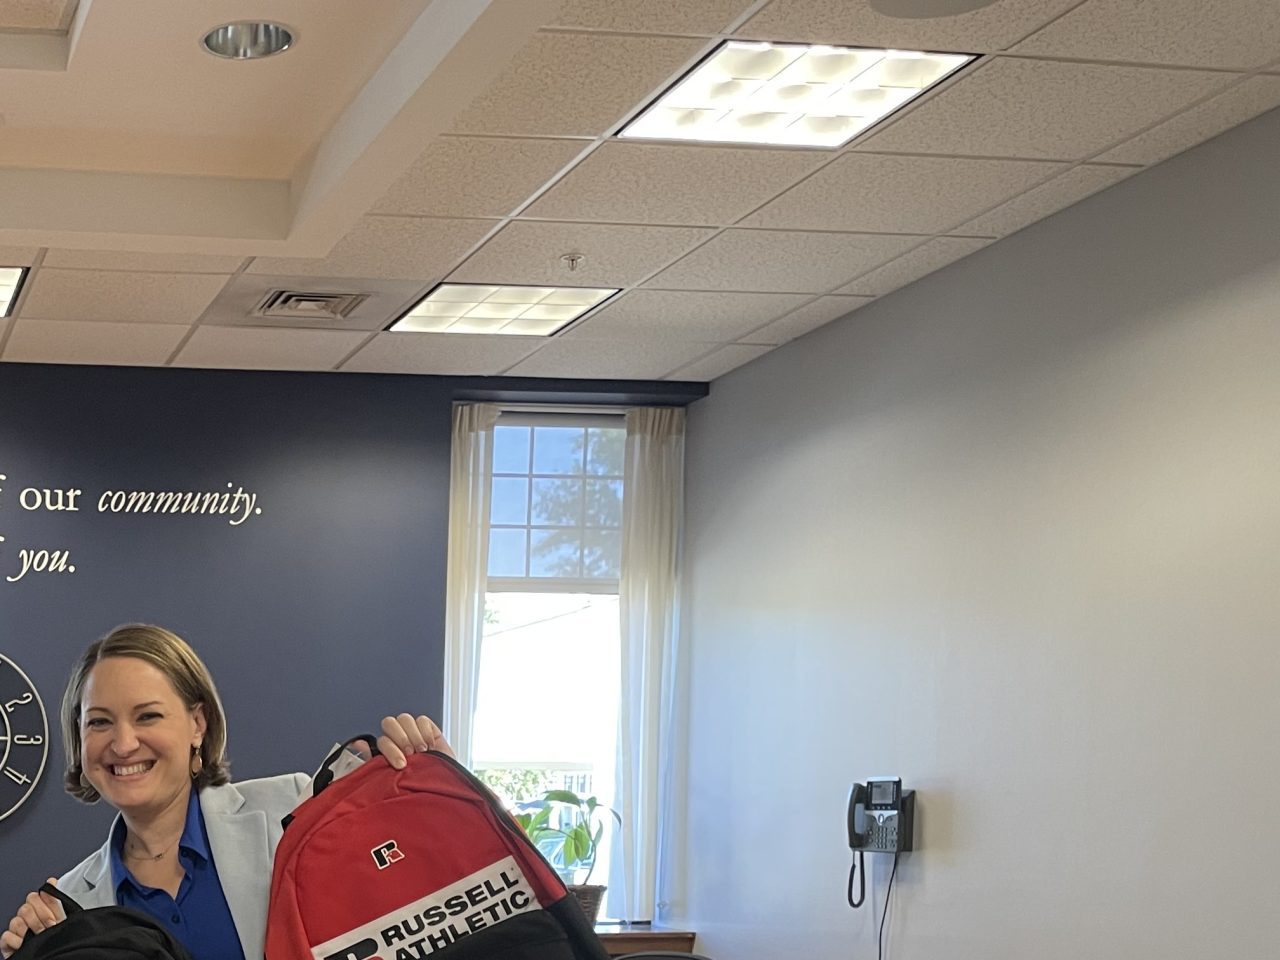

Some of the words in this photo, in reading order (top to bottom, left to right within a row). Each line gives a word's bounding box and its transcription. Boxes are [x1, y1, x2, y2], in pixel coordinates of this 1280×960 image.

[20, 486, 81, 512] our
[98, 482, 263, 525] community.
[7, 548, 76, 581] you.
[4, 691, 33, 713] 2
[13, 734, 43, 745] 3
[3, 765, 32, 785] 4
[380, 871, 520, 949] RUSSELL
